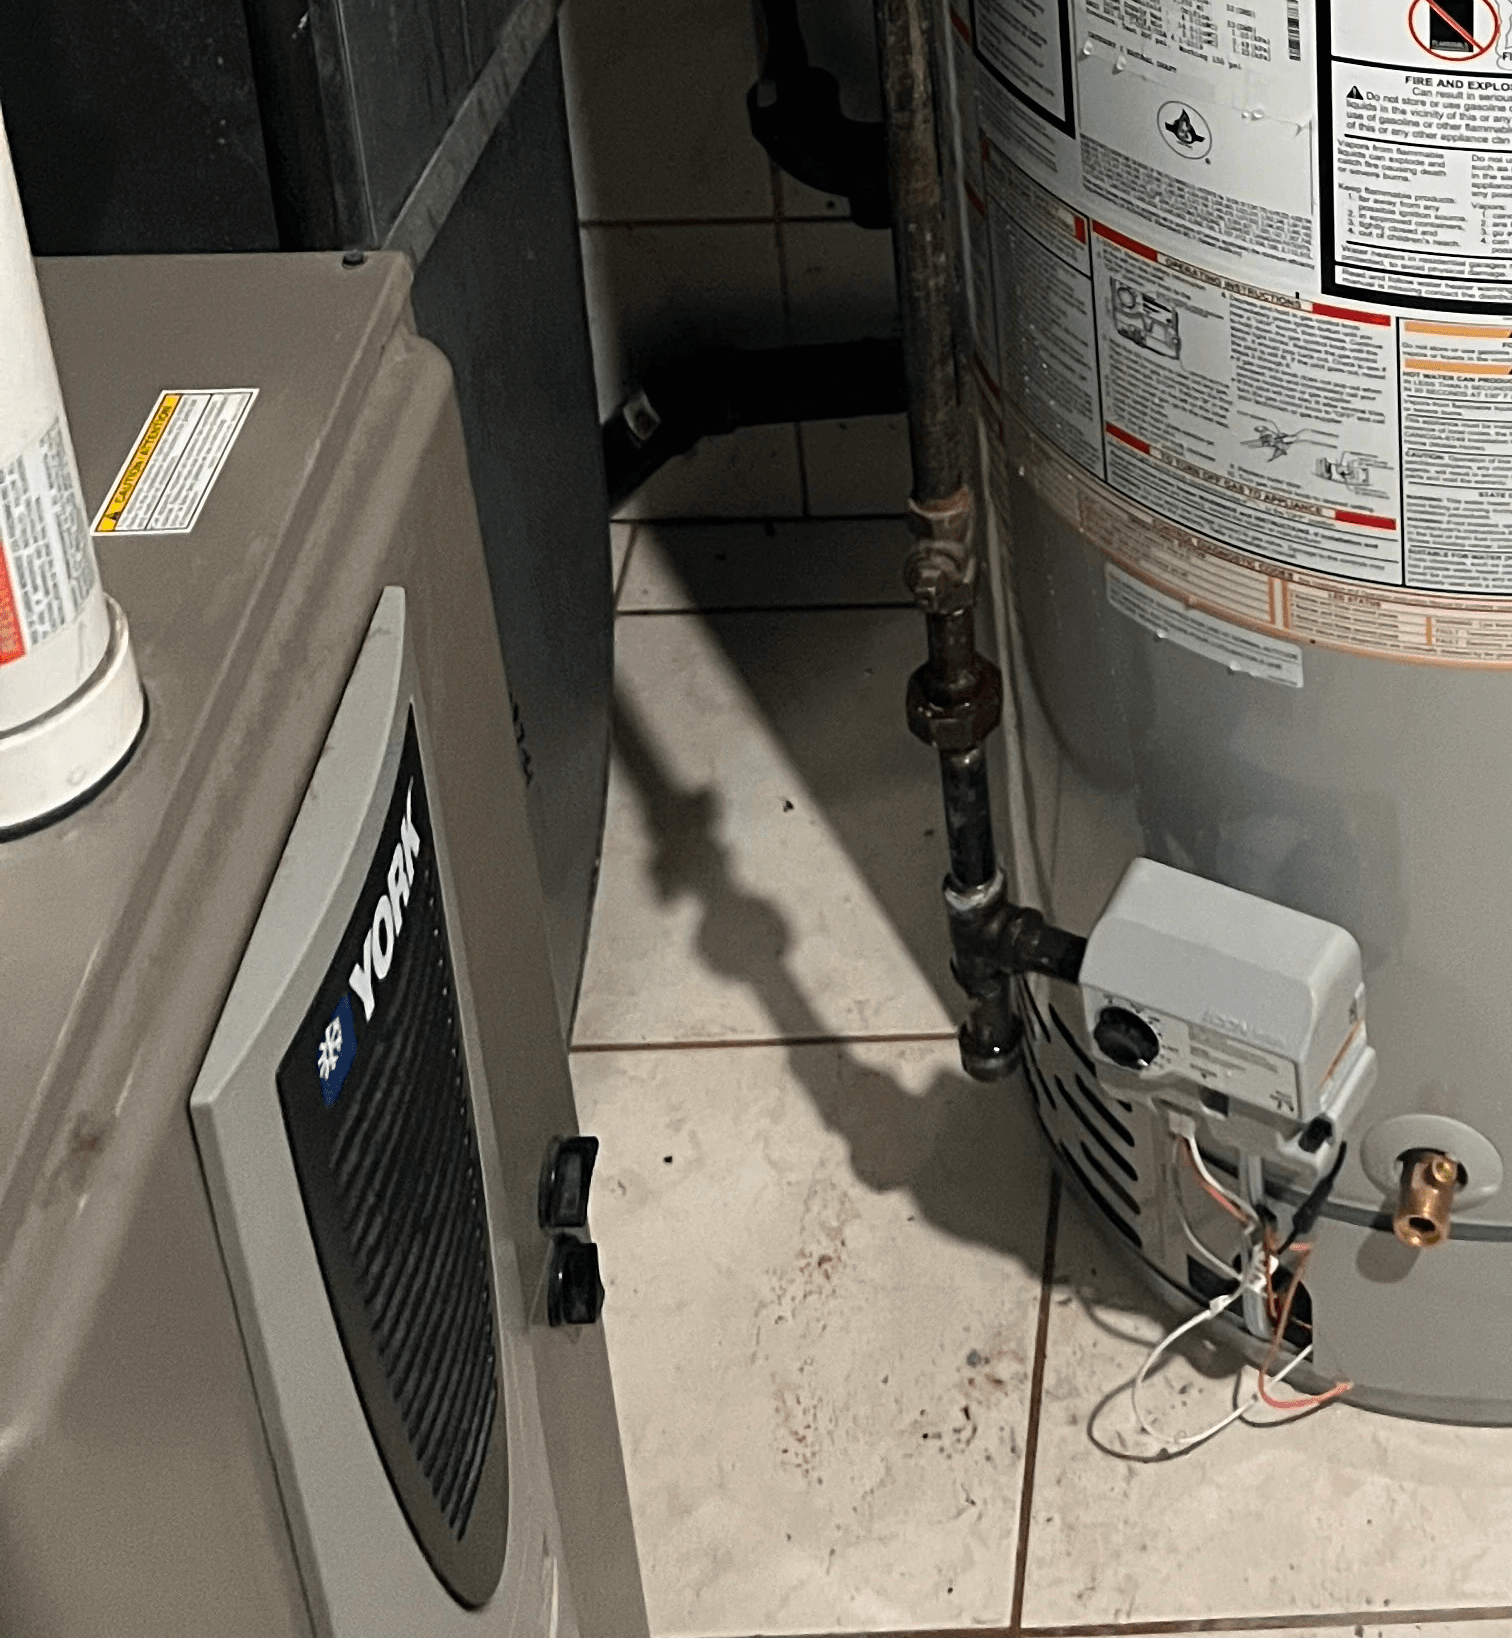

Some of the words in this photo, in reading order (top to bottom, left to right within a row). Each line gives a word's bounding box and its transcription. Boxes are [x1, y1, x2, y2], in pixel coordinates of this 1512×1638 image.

[1404, 76, 1433, 86] FIRE
[1436, 77, 1464, 88] AND
[114, 460, 144, 504] CAUTION
[140, 406, 172, 456] ATTENTION
[348, 776, 421, 1023] YORK
